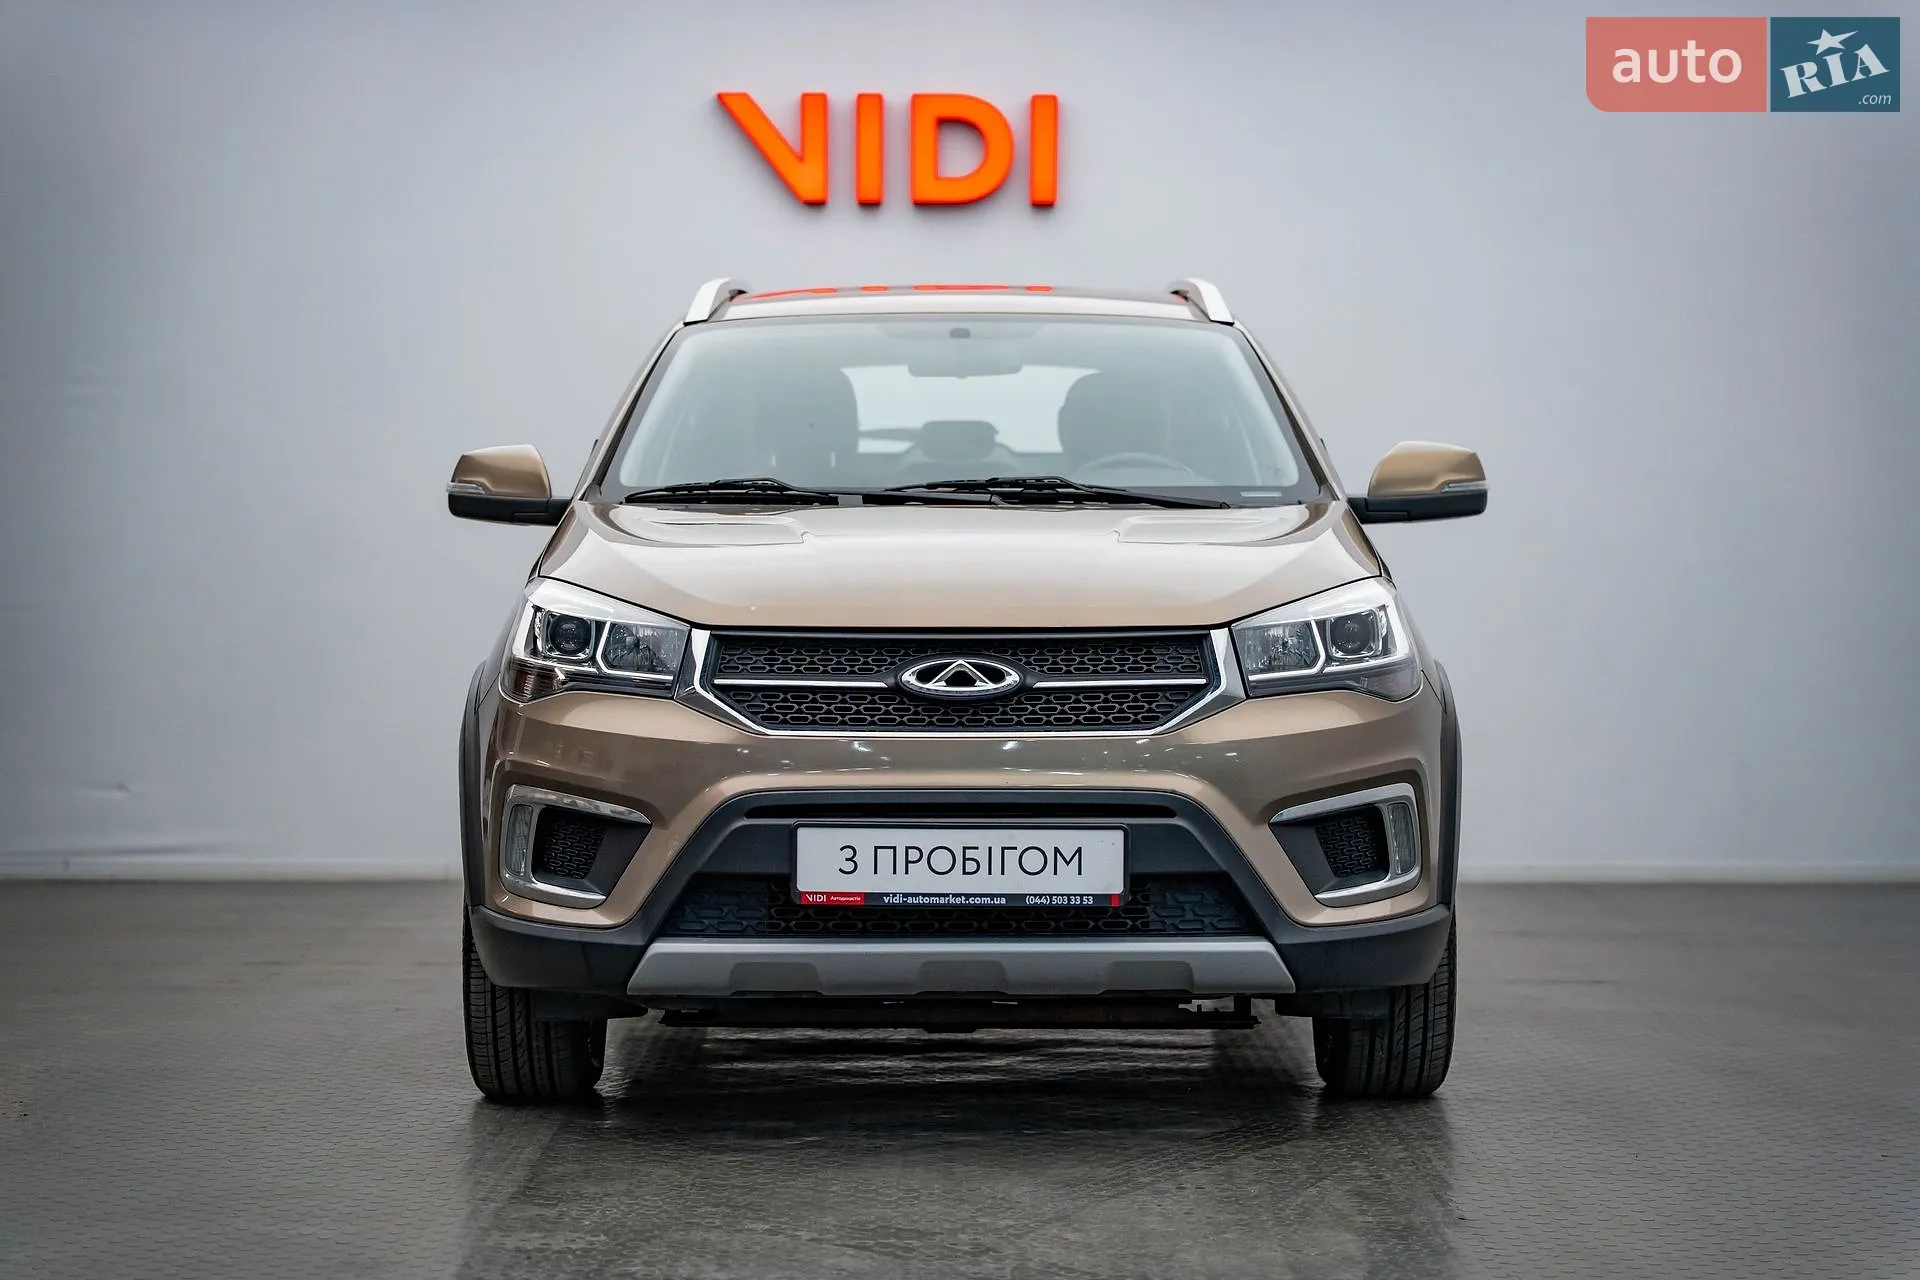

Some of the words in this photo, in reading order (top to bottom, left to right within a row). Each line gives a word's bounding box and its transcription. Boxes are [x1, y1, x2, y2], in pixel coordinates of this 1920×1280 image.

[715, 92, 1059, 207] VIDI
[873, 845, 1083, 876] ПРОБІГОМ
[806, 894, 827, 902] VIDI
[883, 893, 1006, 904] vidi-automarket.com.ua
[1025, 895, 1050, 905] (044)
[1051, 895, 1068, 904] 503
[1069, 895, 1081, 904] 33
[1082, 895, 1094, 904] 53
